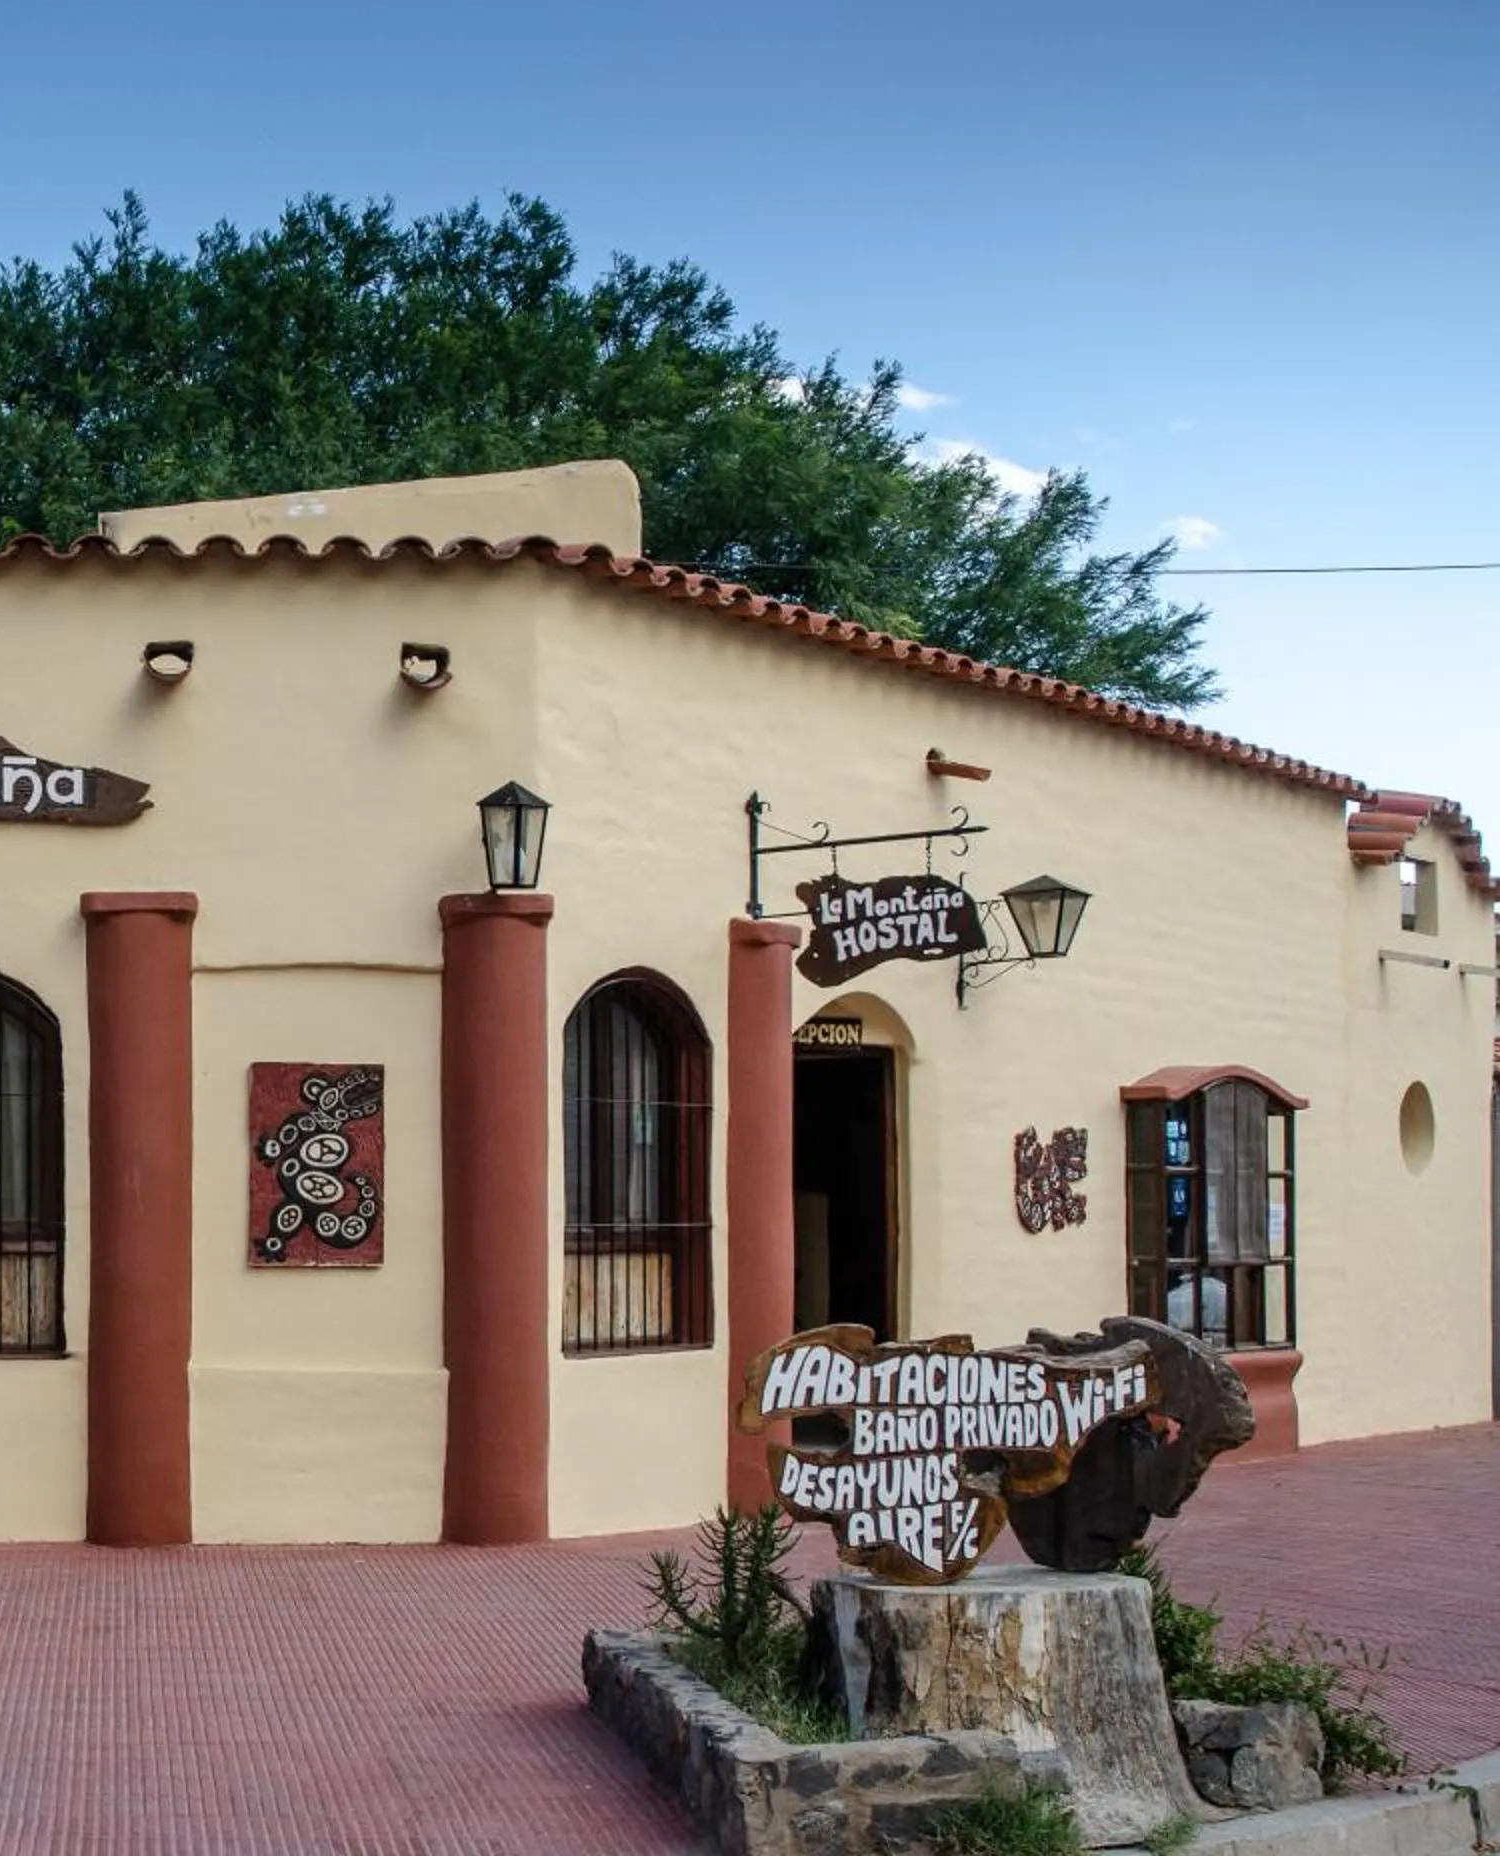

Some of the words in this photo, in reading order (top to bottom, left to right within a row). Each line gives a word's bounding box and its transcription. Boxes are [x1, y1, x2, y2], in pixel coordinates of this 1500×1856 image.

[819, 891, 843, 925] La
[845, 885, 964, 921] Montaña
[832, 909, 959, 962] HOSTAL
[792, 1022, 860, 1045] EPCION
[761, 1344, 1046, 1415] HABITACIONES
[853, 1407, 939, 1456] BAÑO
[944, 1399, 1060, 1449] PRIVADO
[779, 1452, 960, 1511] DESAYUNOS
[847, 1503, 944, 1573] AIRE
